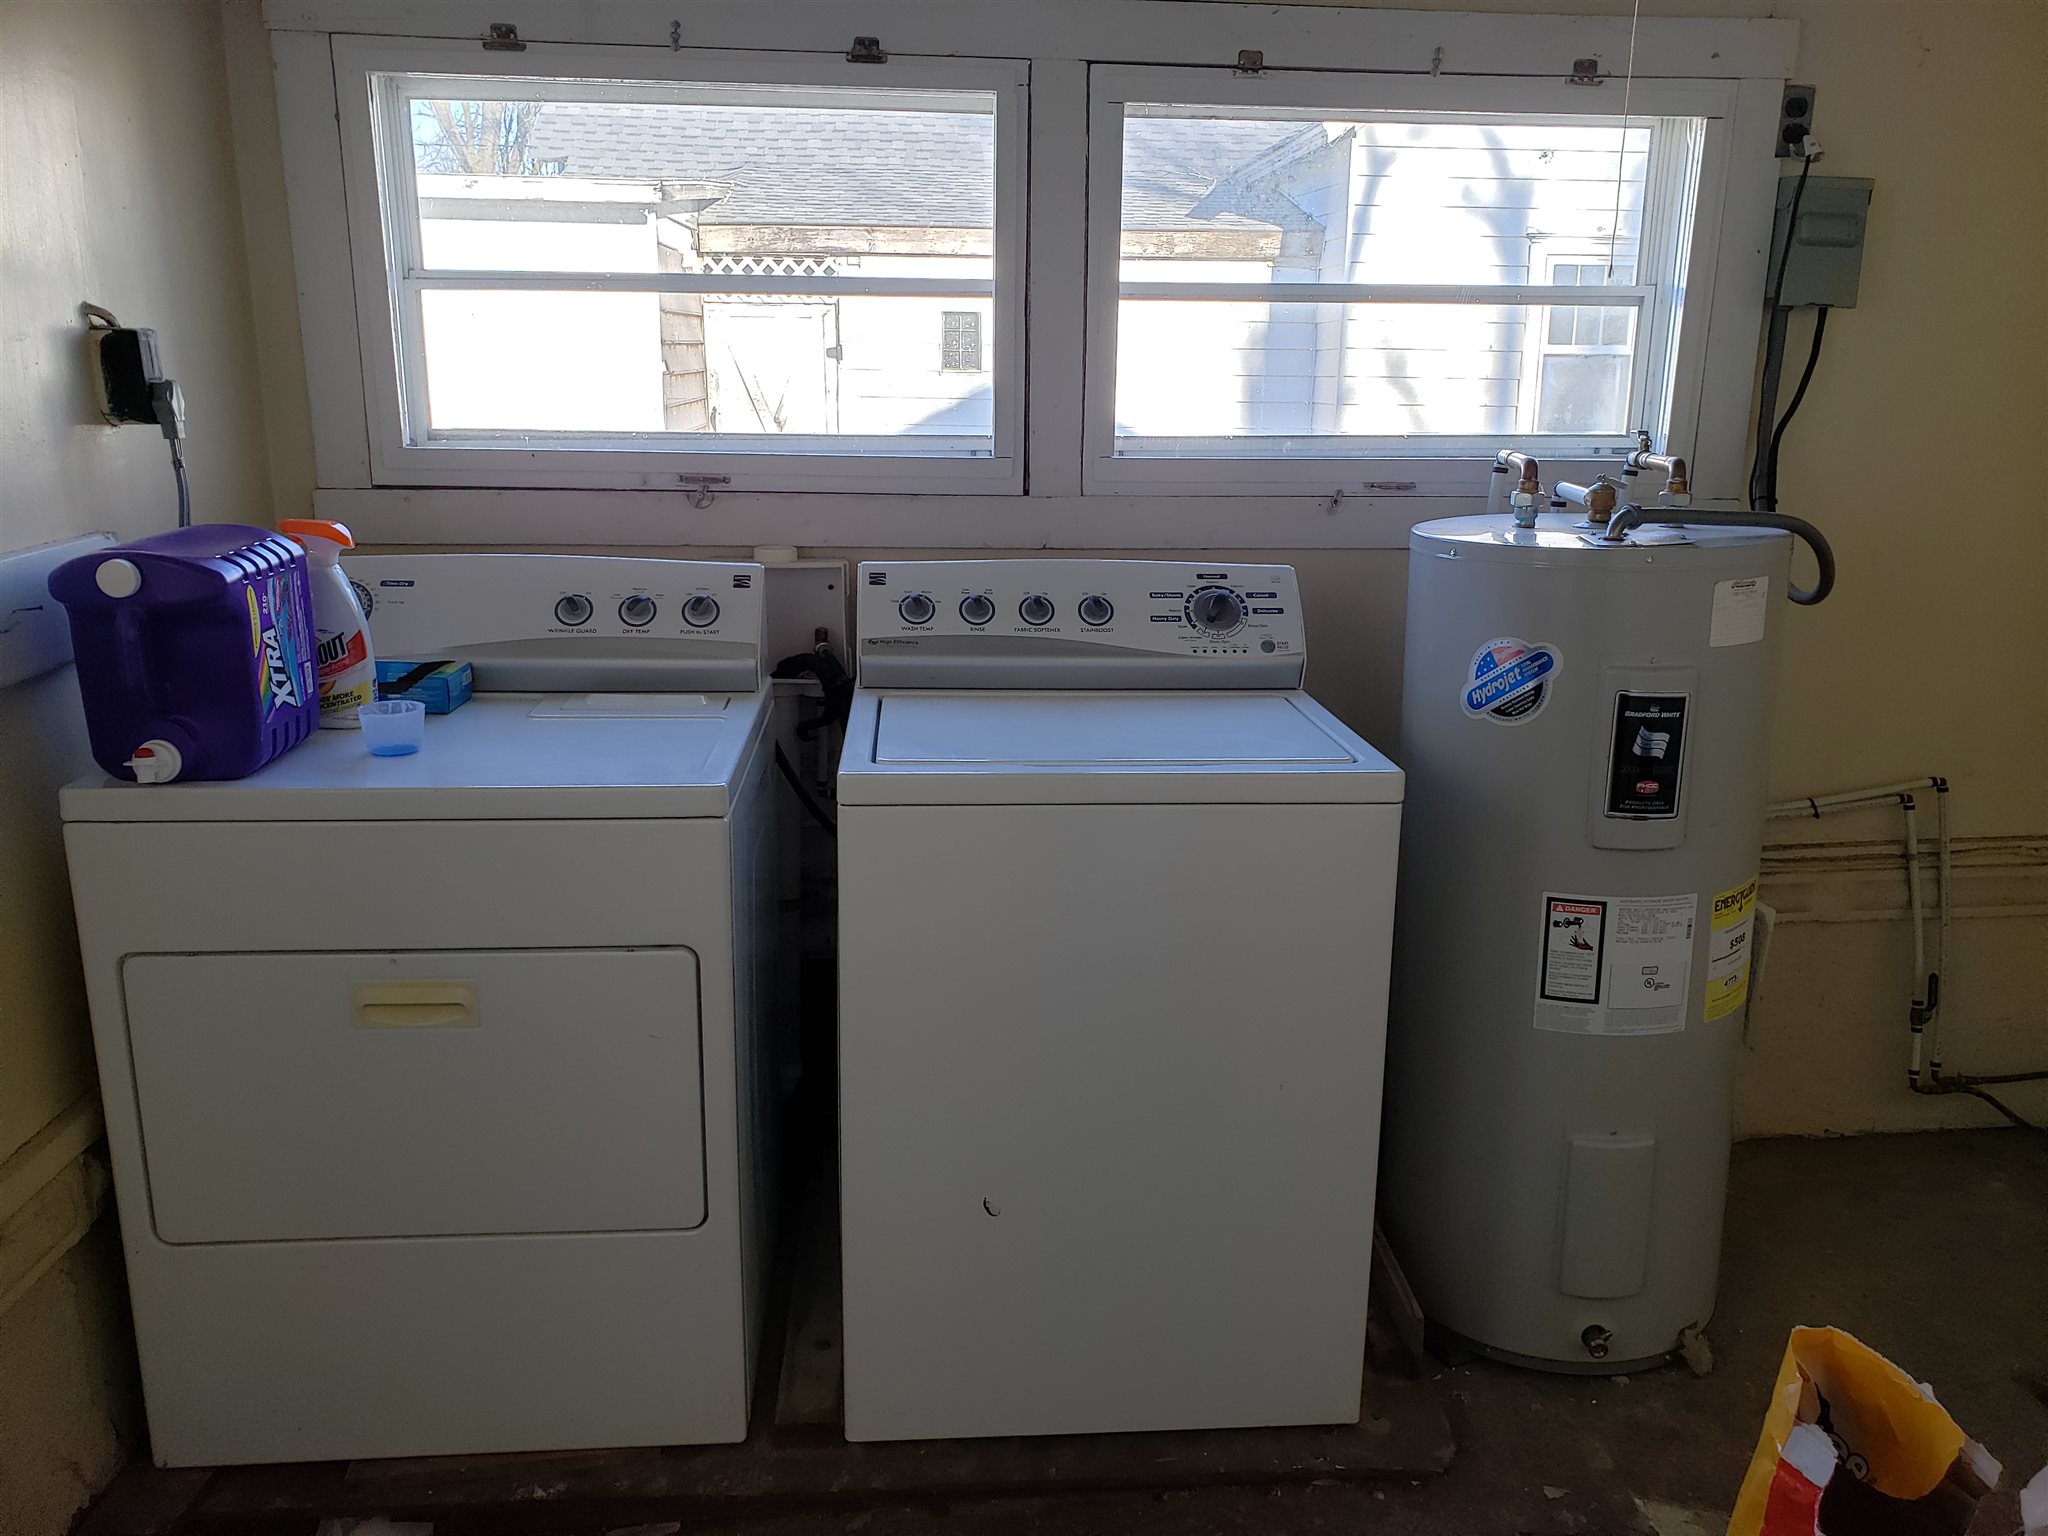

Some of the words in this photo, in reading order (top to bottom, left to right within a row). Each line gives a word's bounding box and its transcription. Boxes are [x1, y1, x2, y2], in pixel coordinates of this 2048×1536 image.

[317, 631, 346, 667] OUT
[262, 626, 298, 710] XTRA
[332, 690, 354, 702] MORE
[1471, 666, 1522, 705] Hydrojet
[1624, 710, 1660, 718] BRADFORD
[1565, 905, 1597, 914] DANGER
